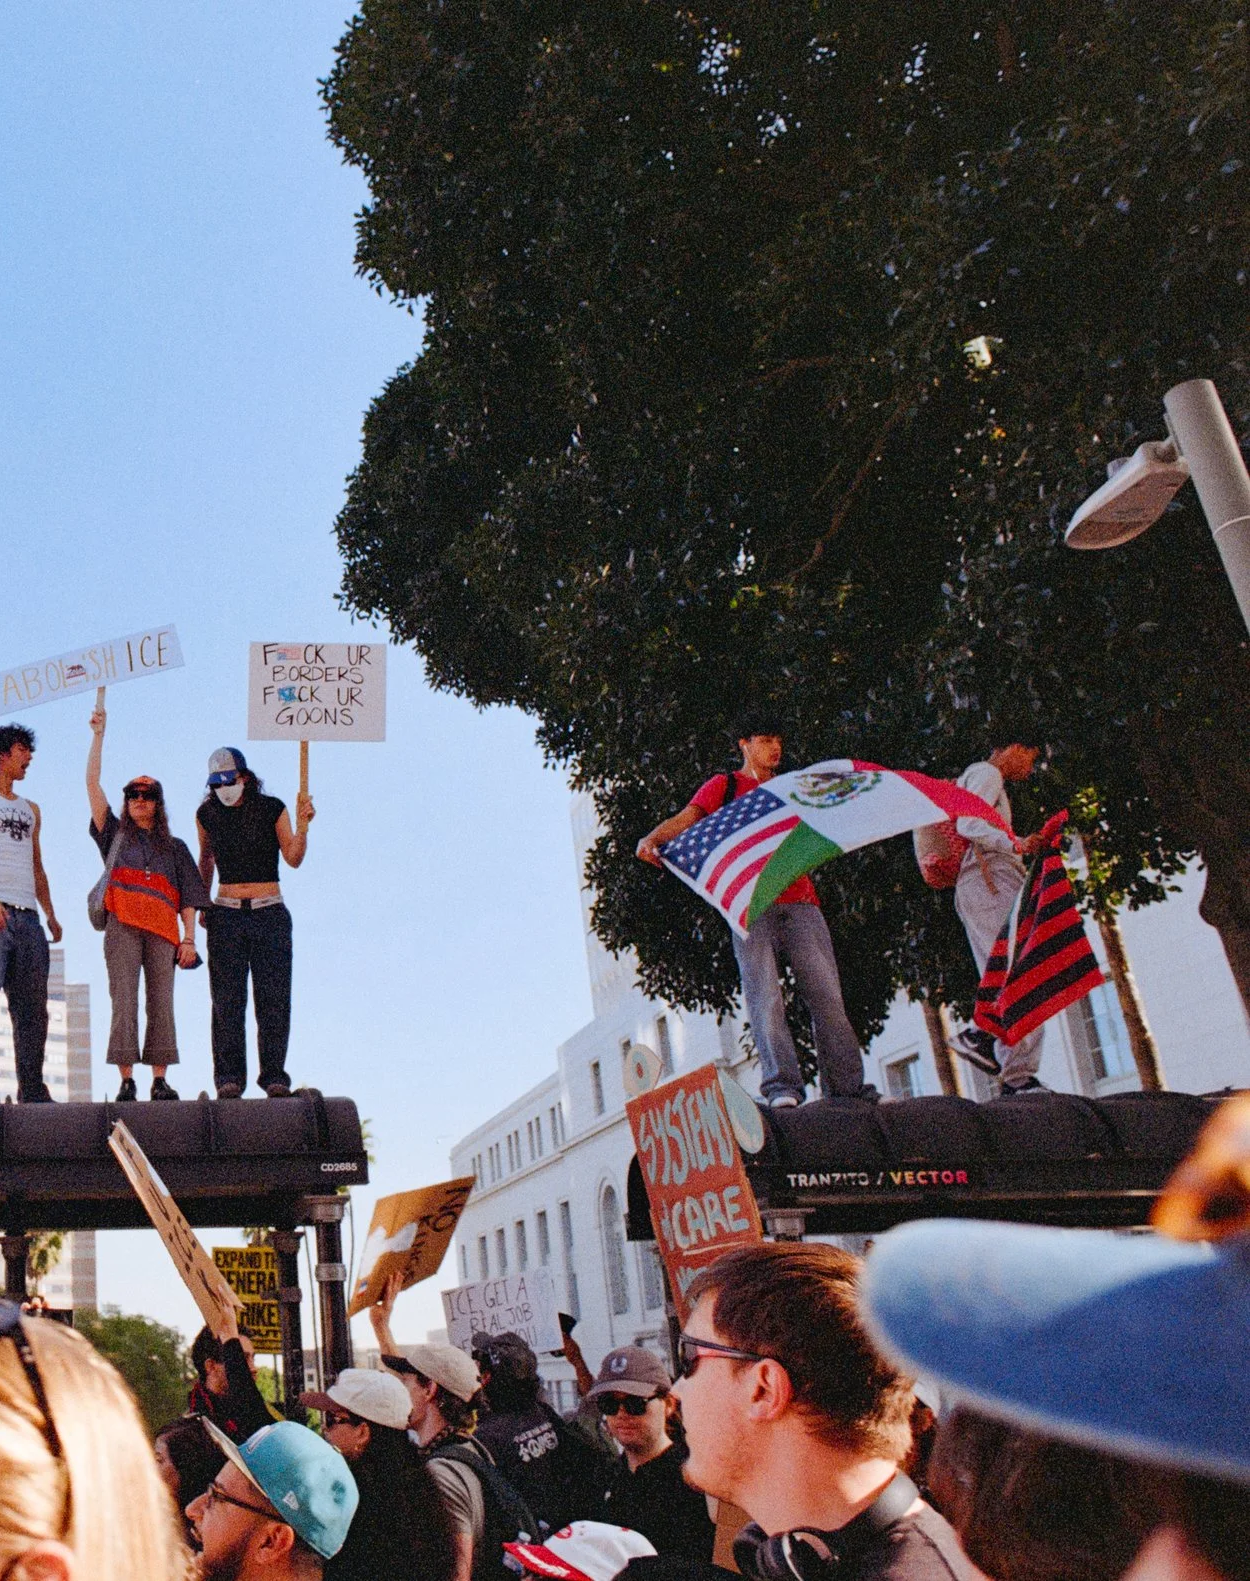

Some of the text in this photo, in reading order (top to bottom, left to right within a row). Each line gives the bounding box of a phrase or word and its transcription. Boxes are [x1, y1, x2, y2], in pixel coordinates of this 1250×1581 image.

[126, 631, 169, 672] ICE
[263, 643, 371, 666] FCK UR
[272, 665, 364, 684] BORDERS
[263, 686, 364, 707] FCK UR
[275, 706, 354, 726] GOONS
[787, 1172, 869, 1187] TRANZITO
[889, 1170, 969, 1185] VECTOR
[672, 1185, 749, 1249] CARE
[215, 1251, 262, 1269] EXPAND
[483, 1279, 509, 1308] GET
[516, 1277, 528, 1301] A
[470, 1302, 534, 1333] REAL JOB
